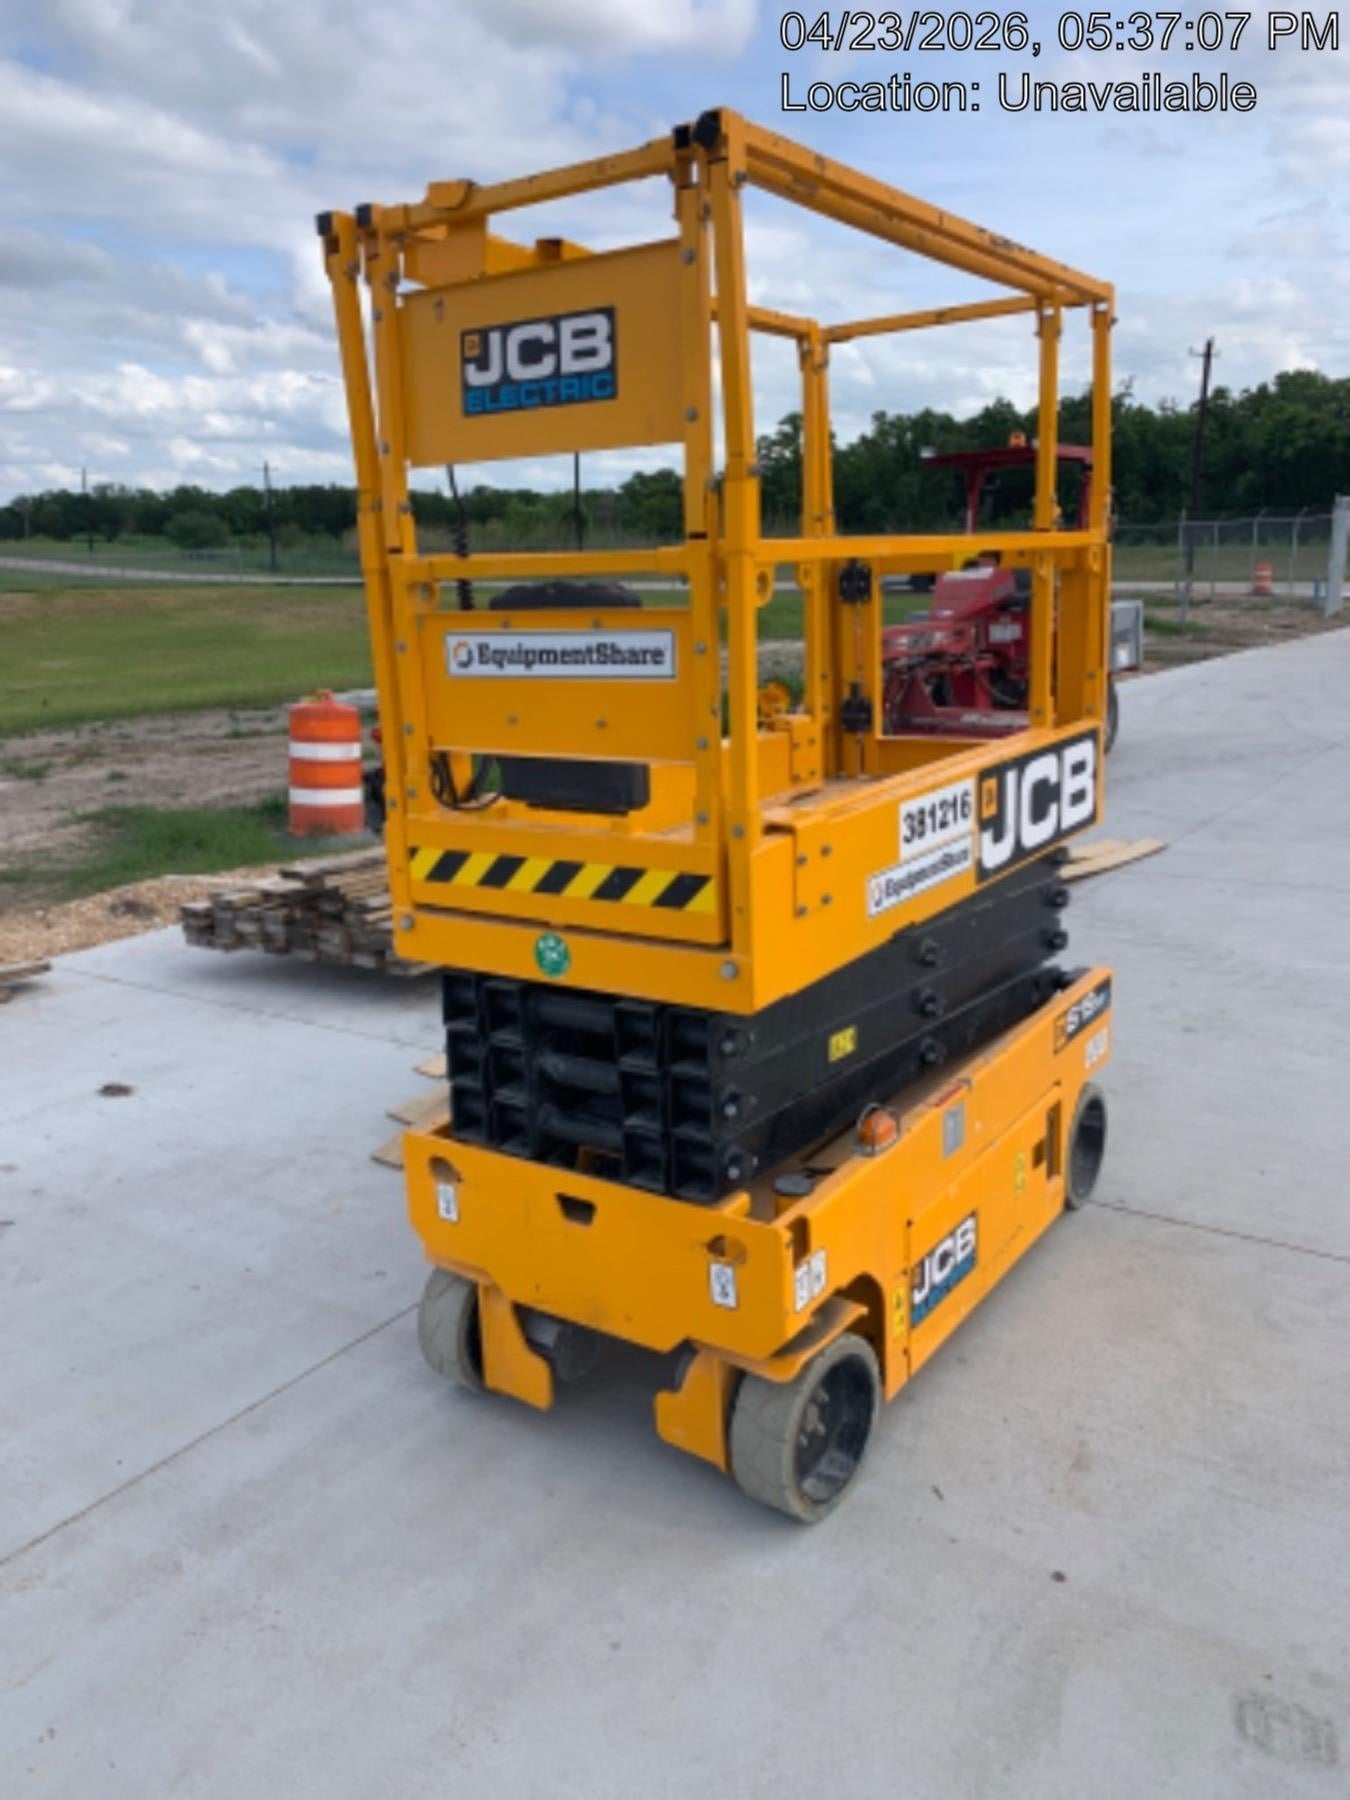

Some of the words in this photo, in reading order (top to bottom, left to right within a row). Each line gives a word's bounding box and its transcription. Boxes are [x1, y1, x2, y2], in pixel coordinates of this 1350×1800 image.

[464, 313, 613, 386] JCB
[465, 371, 614, 416] ELECTRIC
[476, 642, 665, 671] EquipmentShare
[902, 789, 972, 845] 381216
[980, 738, 1097, 869] JCB
[913, 1216, 976, 1305] JCB
